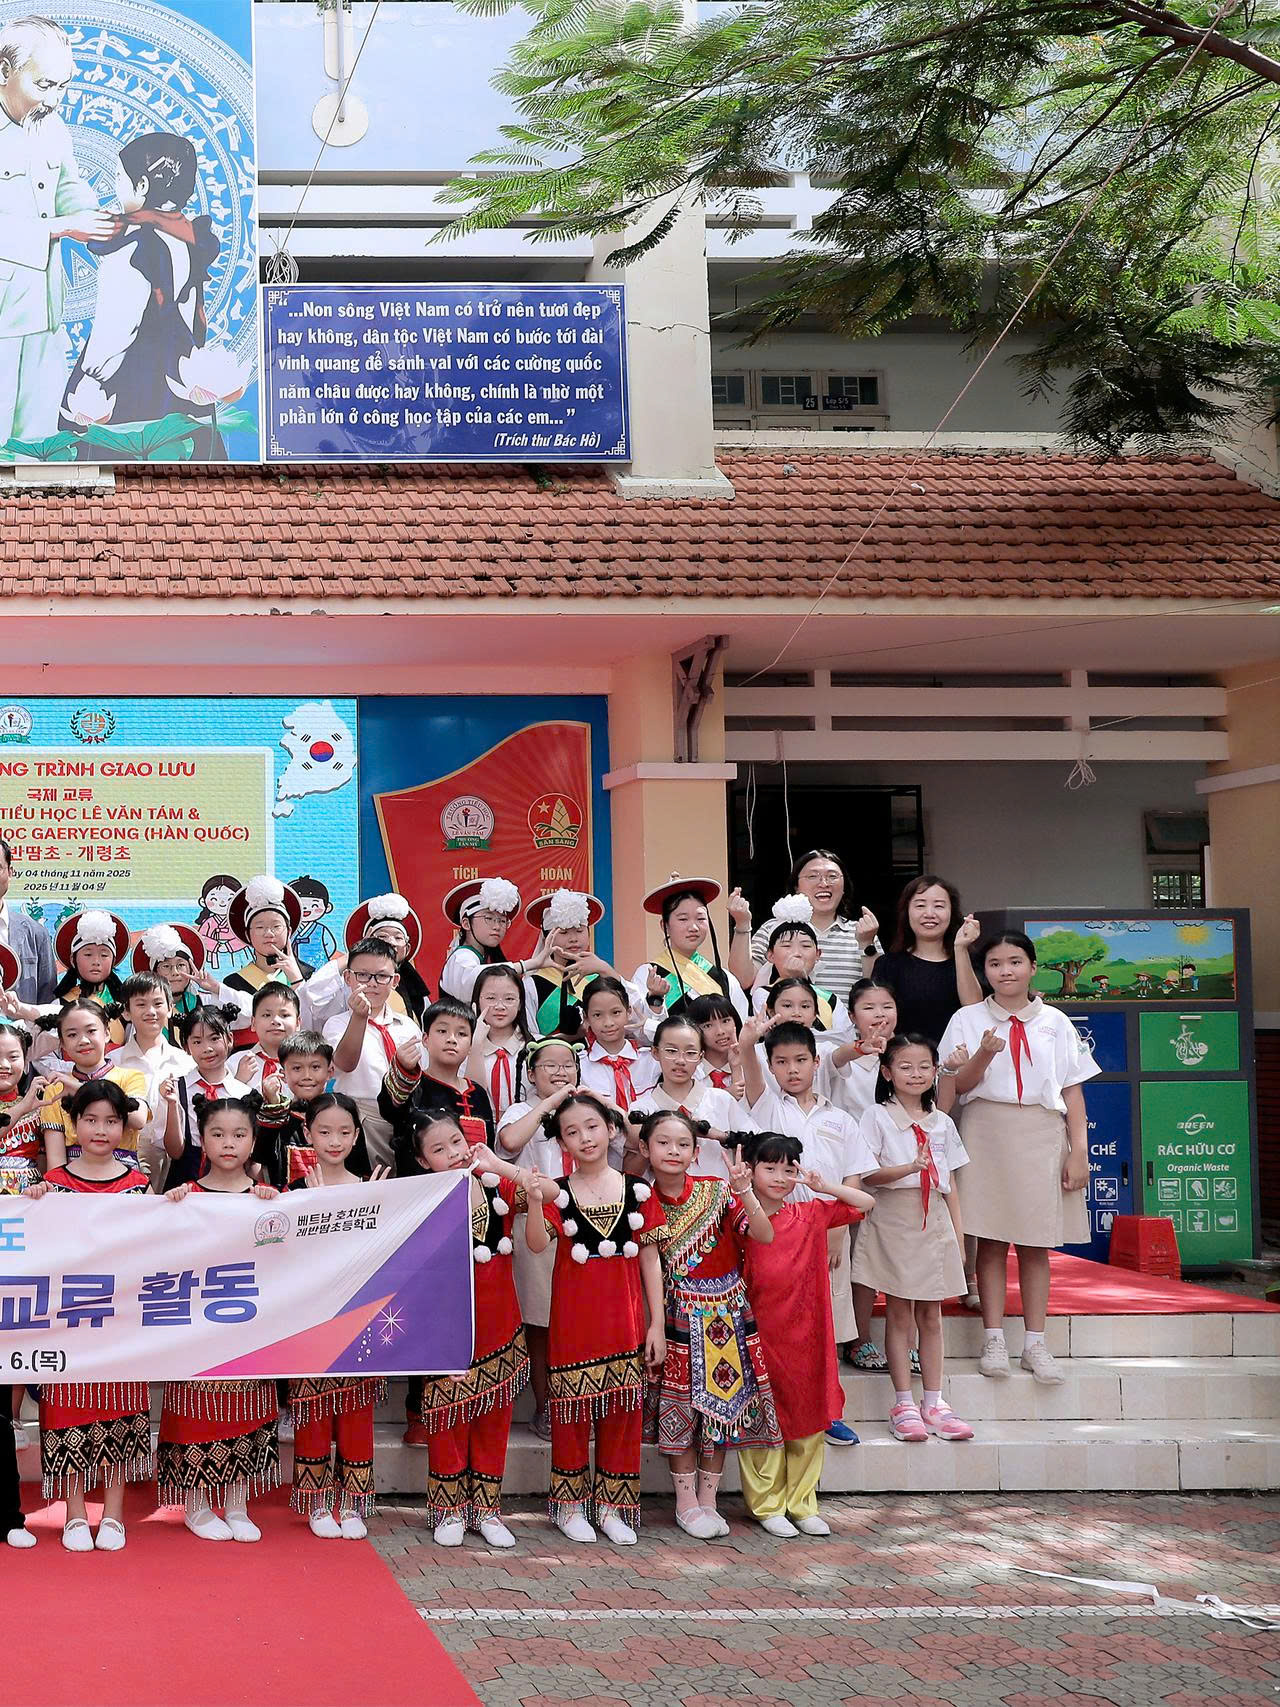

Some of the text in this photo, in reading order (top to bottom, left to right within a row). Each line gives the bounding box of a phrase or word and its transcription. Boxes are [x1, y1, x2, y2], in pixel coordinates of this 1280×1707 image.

[337, 302, 375, 320] sông
[379, 302, 411, 321] Việt
[415, 302, 449, 317] Nam
[455, 301, 473, 317] có
[478, 299, 501, 317] trở
[506, 302, 535, 317] nên
[539, 302, 569, 317] tươi
[573, 302, 601, 320] đẹp
[277, 327, 603, 347] hay không, dân tộc Việt Nam có bước tới đài
[278, 350, 602, 373] vinh quang để sánh vai với các cường quốc
[279, 383, 604, 402] năm châu được hay không, chính là nhờ một
[805, 397, 815, 408] 25
[279, 405, 316, 426] phần
[321, 408, 344, 424] lớn
[349, 407, 359, 424] ở
[363, 409, 399, 427] công
[404, 408, 432, 427] học
[436, 408, 461, 427] tập
[465, 405, 492, 424] của
[496, 408, 523, 424] các
[494, 431, 601, 448] (Trích thư Bác Hồ)
[35, 759, 94, 777] TRÌNH
[100, 762, 153, 777] GIAO
[159, 761, 195, 777] LƯU
[26, 787, 94, 802] 국제 교류
[0, 804, 35, 820] TIỂU
[40, 807, 77, 822] HỌC
[82, 805, 102, 820] LÊ
[106, 805, 142, 820] VĂN
[147, 804, 183, 820] TÁM
[188, 807, 200, 820] &
[31, 827, 139, 840] GAERYEONG
[144, 824, 189, 841] (HÀN
[194, 824, 250, 842] QUỐC)
[78, 845, 131, 861] 개령초
[40, 869, 69, 879] tháng
[452, 864, 479, 880] TÍCH
[1090, 1141, 1117, 1155] CHẾ
[1158, 1142, 1236, 1155] RÁC HỮU CƠ
[1167, 1163, 1230, 1174] Organic Waste
[297, 1212, 332, 1227] 베트남
[335, 1204, 381, 1220] 호치민시
[296, 1217, 377, 1237] 레반땀초등학교
[137, 1261, 259, 1327] 활동
[10, 1349, 67, 1372] 6.(목)
